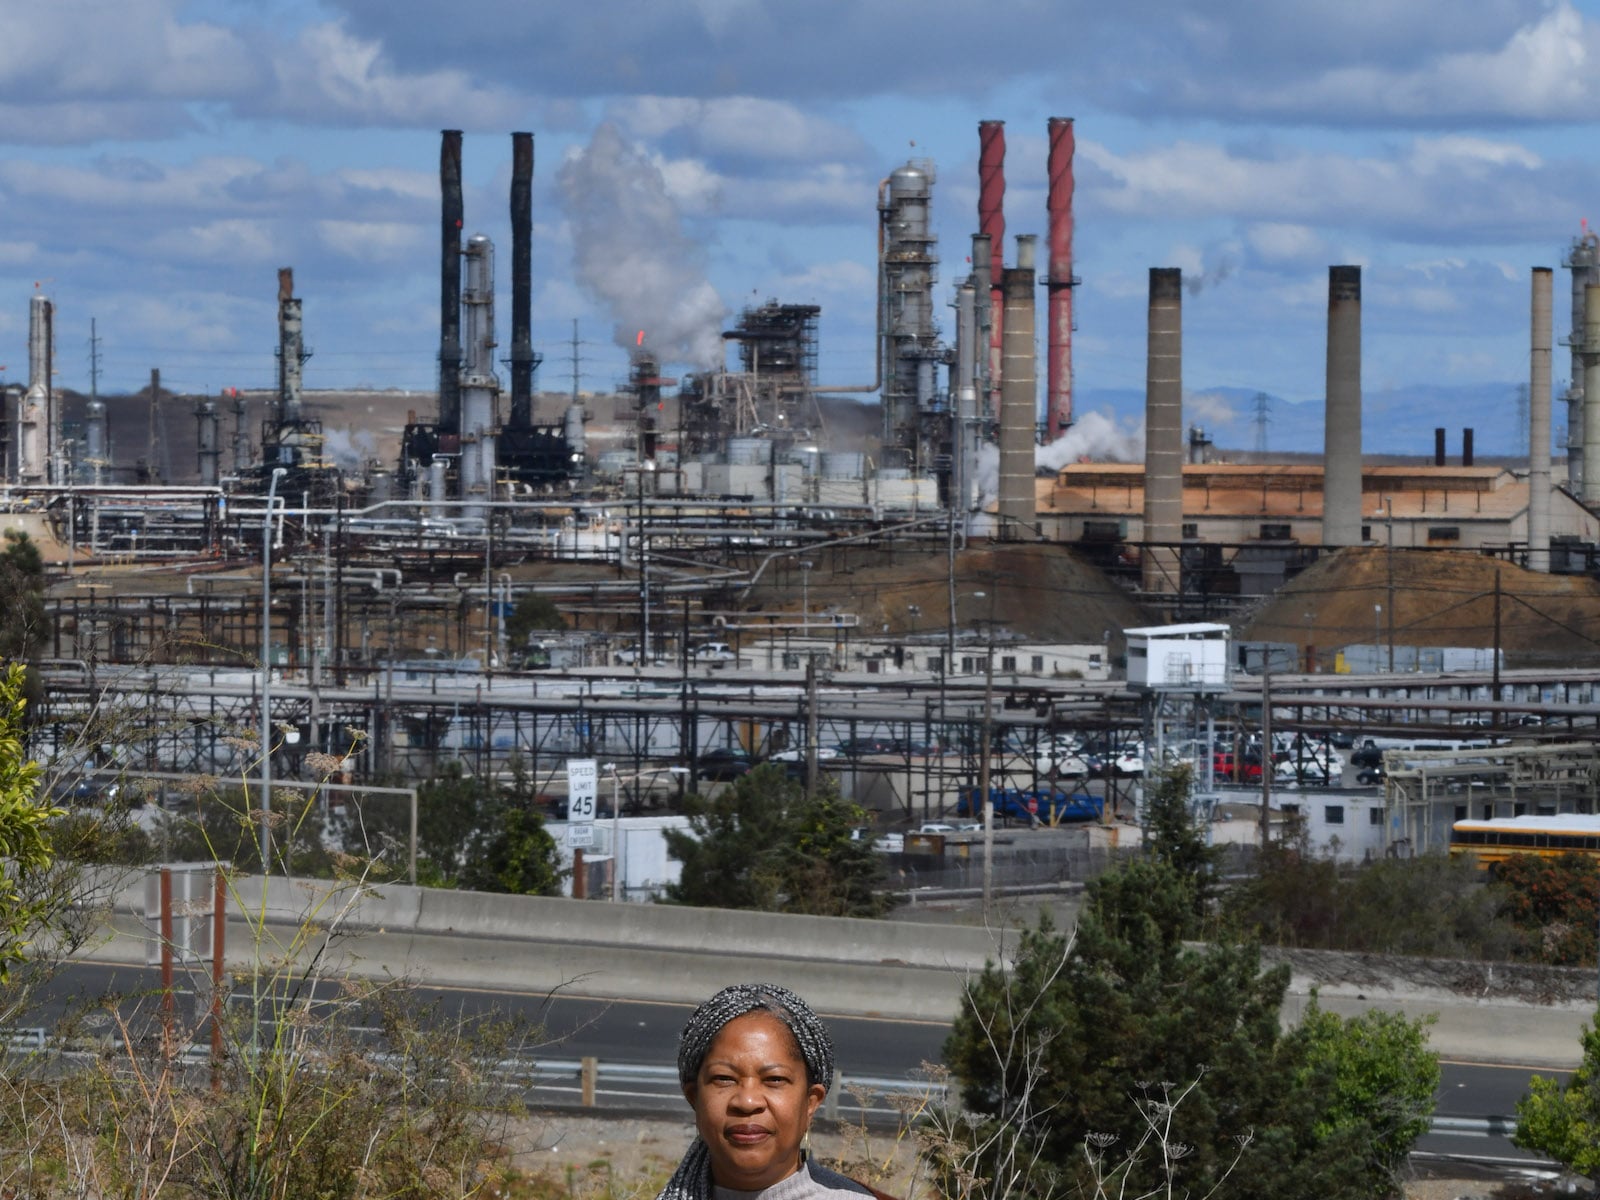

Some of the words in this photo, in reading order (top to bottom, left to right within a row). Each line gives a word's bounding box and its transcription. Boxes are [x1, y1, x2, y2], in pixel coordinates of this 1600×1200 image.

[570, 767, 594, 777] SPEED
[573, 781, 592, 791] LIMIT
[572, 796, 593, 816] 45
